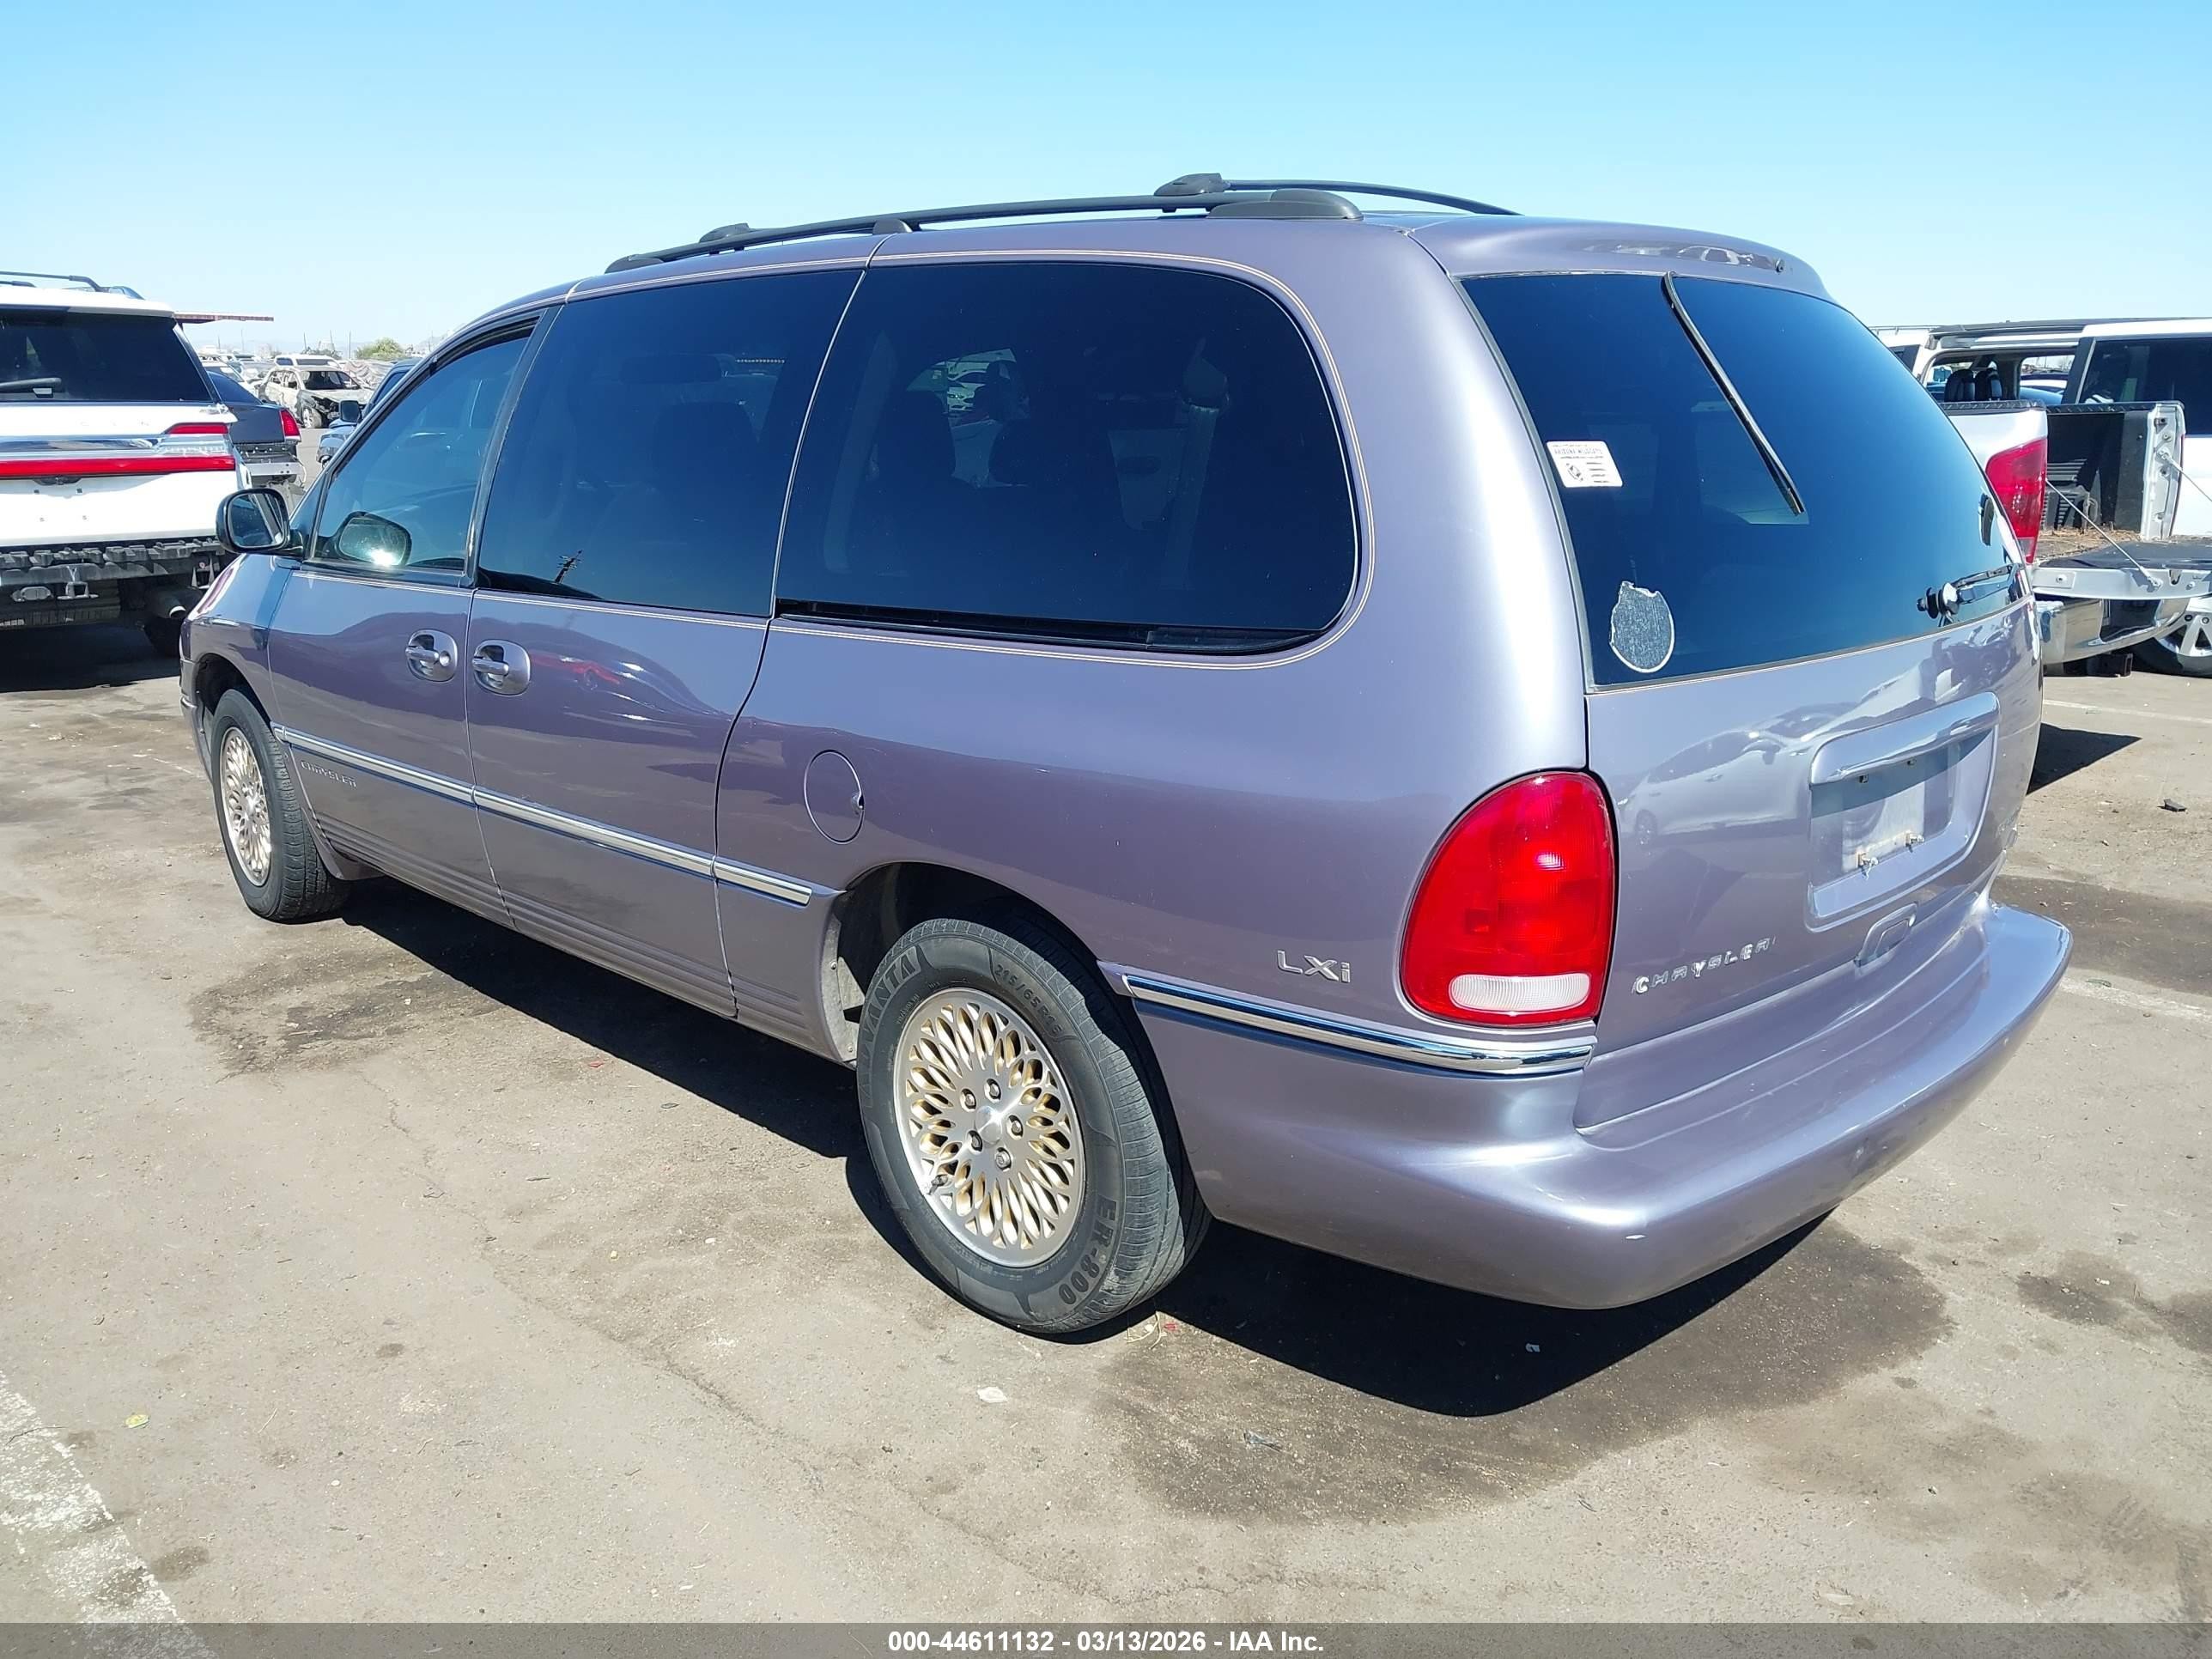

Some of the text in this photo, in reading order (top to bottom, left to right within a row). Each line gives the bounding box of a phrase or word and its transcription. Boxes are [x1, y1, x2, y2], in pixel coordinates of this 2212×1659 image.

[300, 760, 358, 788] CHRYSLER
[1277, 950, 1351, 983] LXi
[1633, 937, 1772, 994] CHRYSLER
[1059, 1196, 1117, 1305] ER-800
